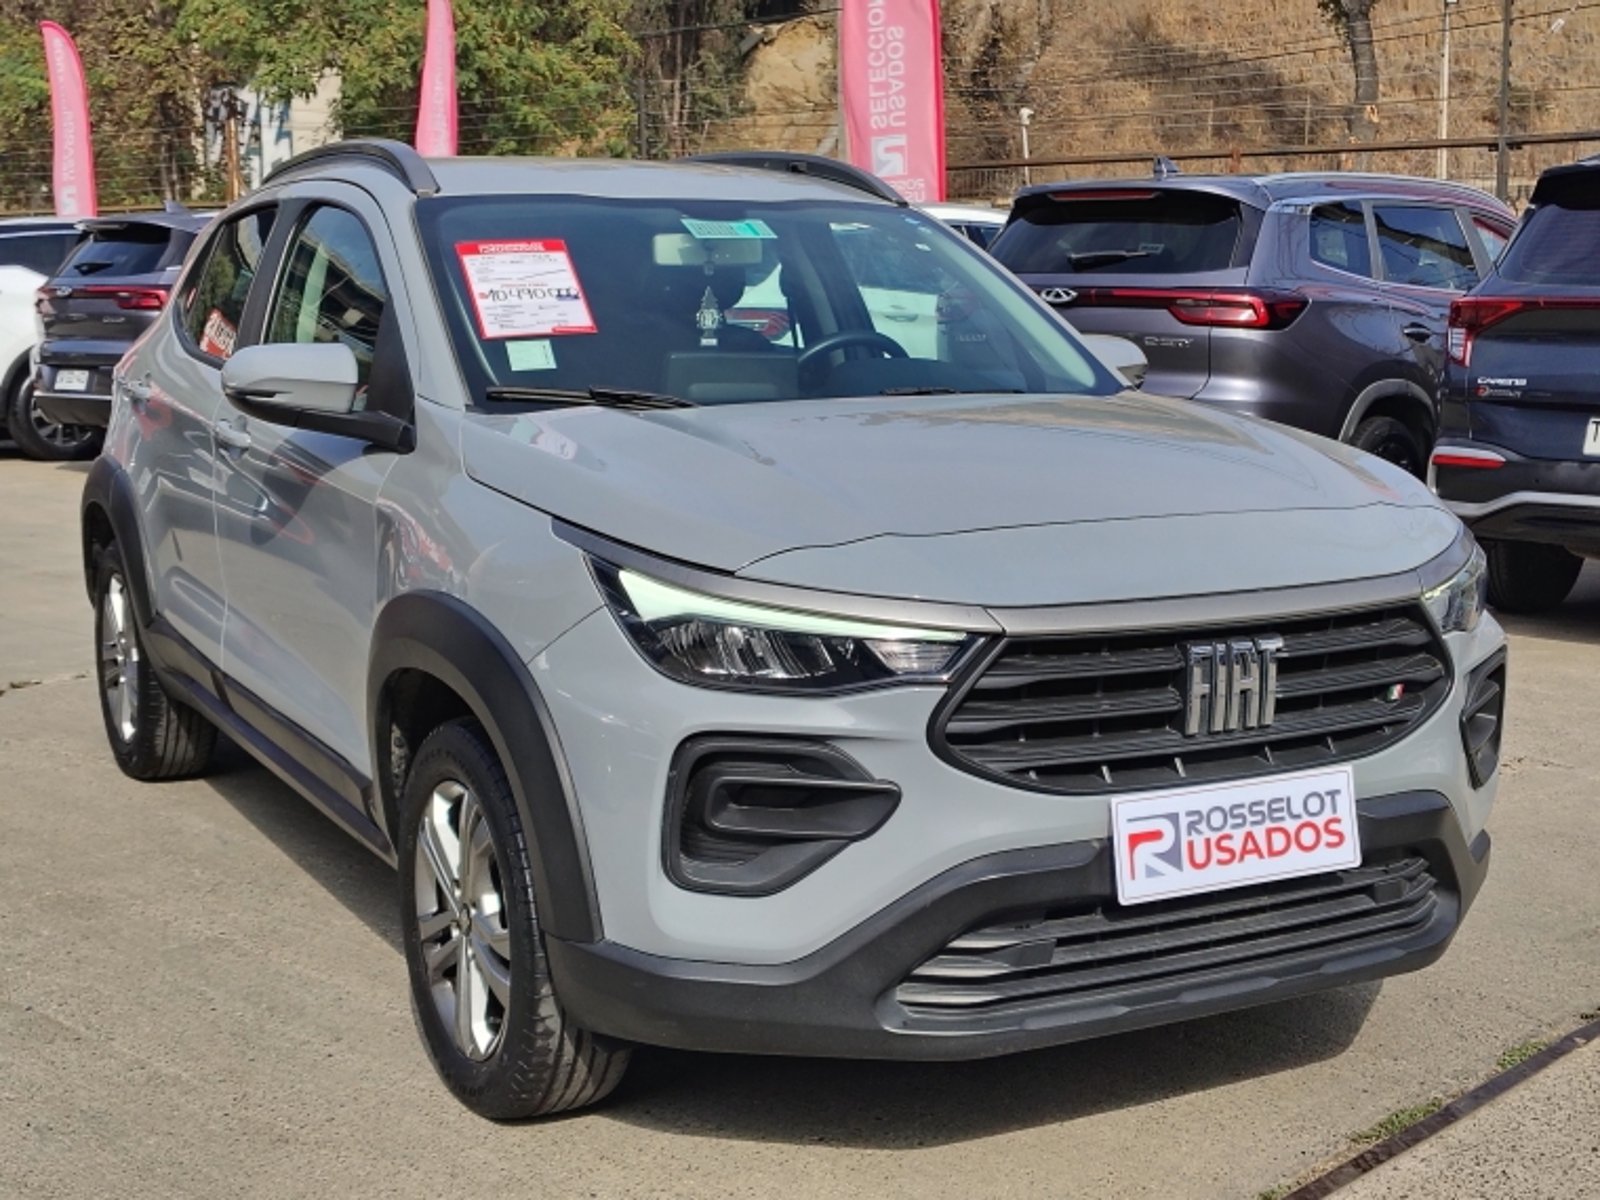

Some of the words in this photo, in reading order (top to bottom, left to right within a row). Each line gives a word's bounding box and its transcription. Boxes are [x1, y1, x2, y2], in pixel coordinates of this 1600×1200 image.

[1184, 637, 1284, 735] FIAT
[1185, 789, 1341, 836] ROSSELOT
[1186, 817, 1346, 870] USADOS
